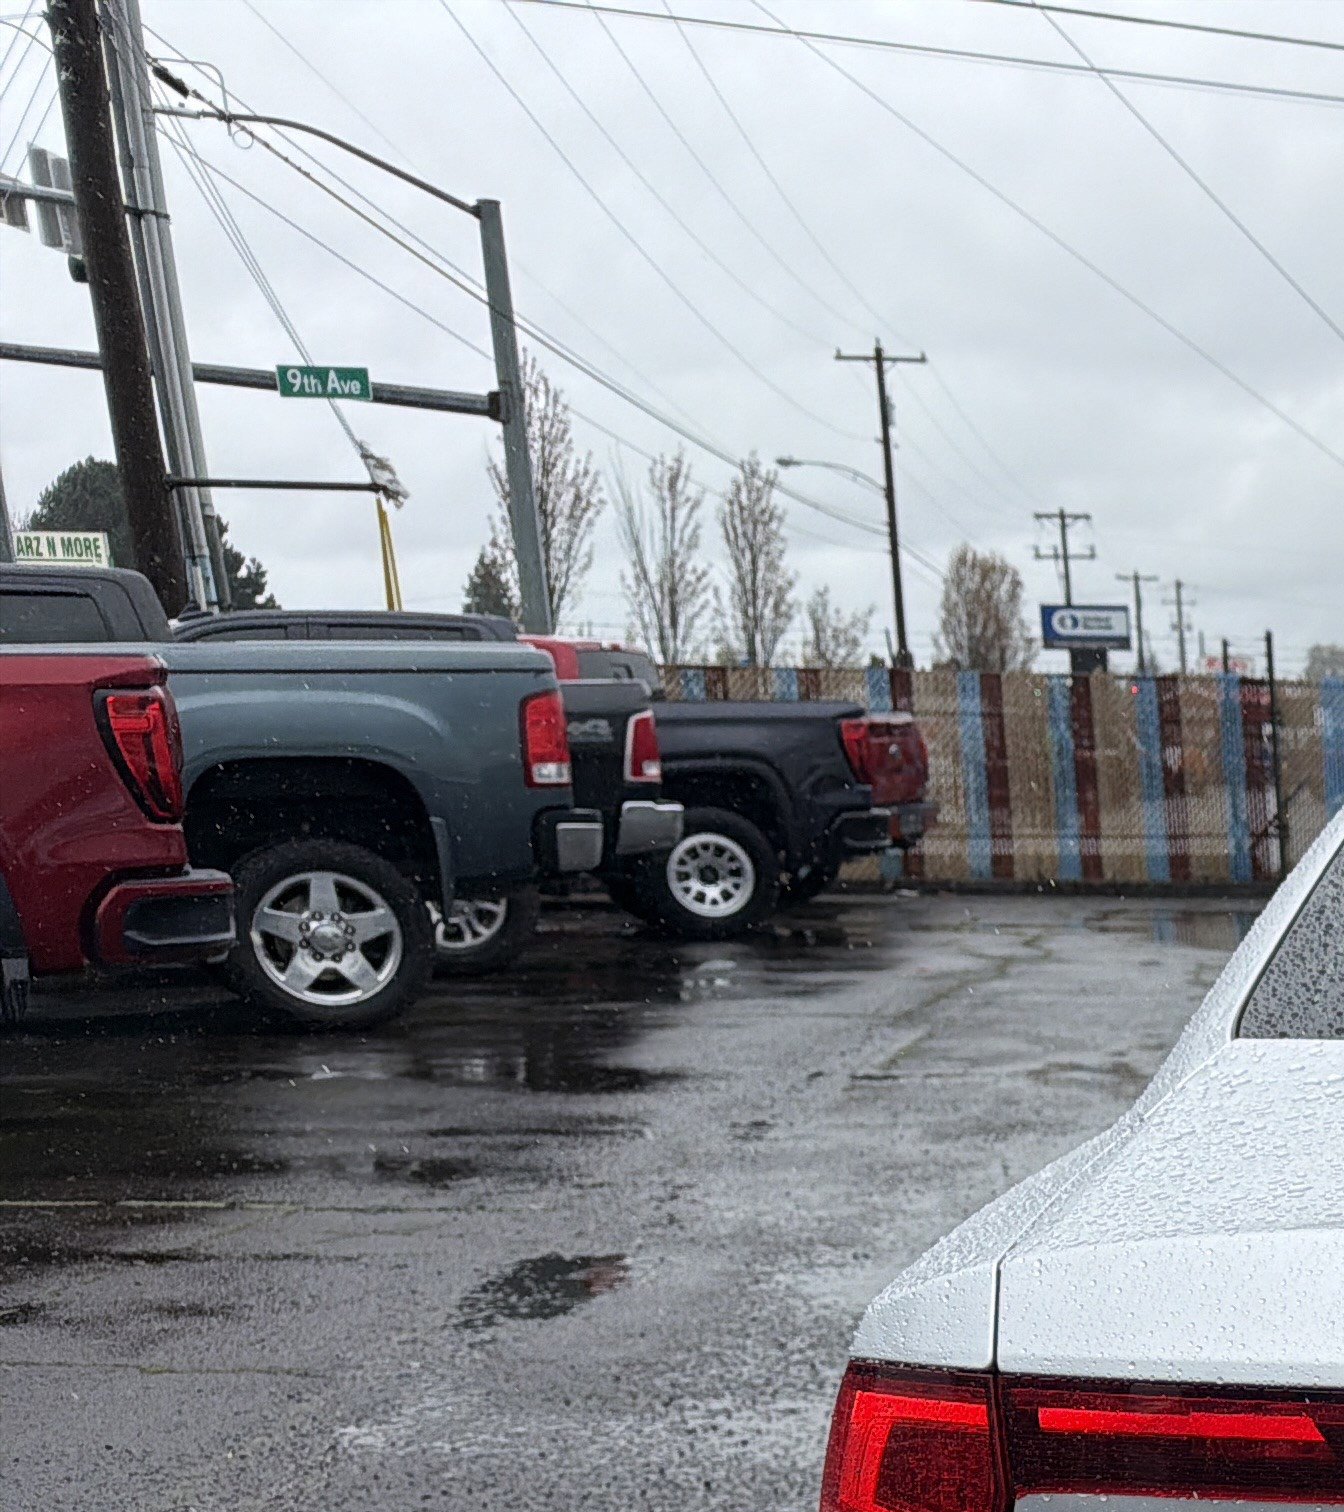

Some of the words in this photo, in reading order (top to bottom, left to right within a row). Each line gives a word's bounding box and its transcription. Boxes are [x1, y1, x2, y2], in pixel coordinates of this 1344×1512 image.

[286, 368, 322, 394] 9th
[326, 369, 361, 395] Ave
[46, 536, 57, 557] N
[60, 536, 102, 558] MORE
